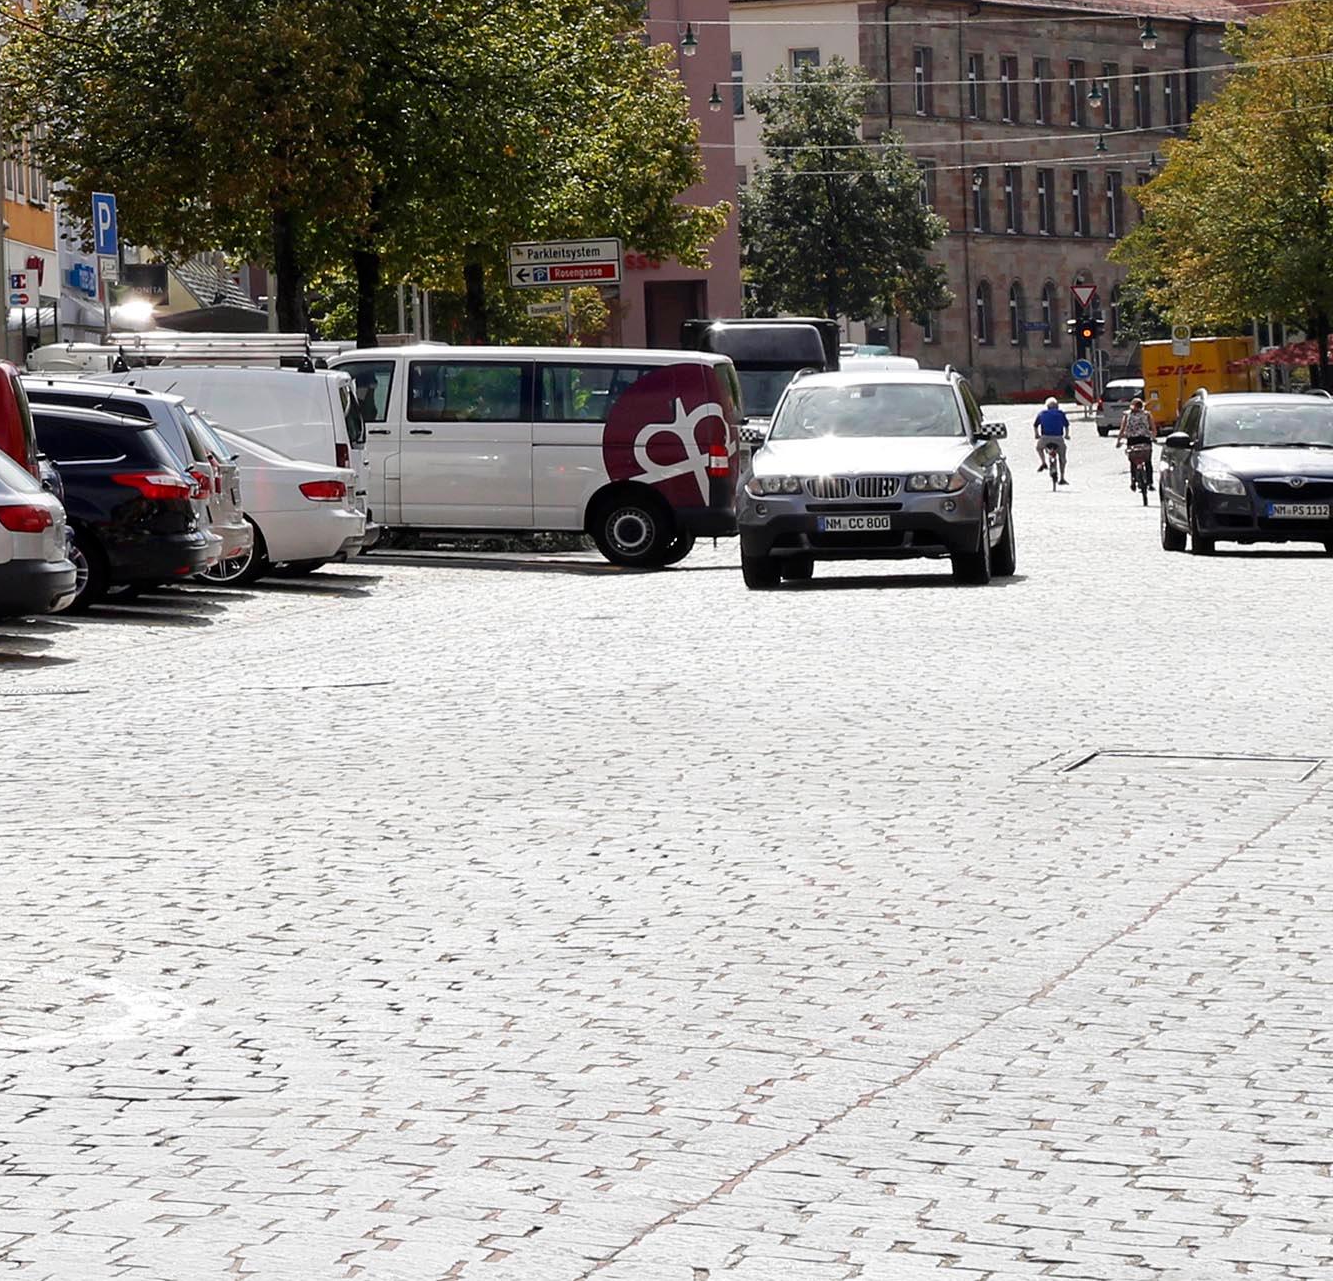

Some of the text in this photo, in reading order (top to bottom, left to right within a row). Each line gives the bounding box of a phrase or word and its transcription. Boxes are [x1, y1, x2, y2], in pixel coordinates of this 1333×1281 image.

[97, 201, 112, 247] P
[527, 247, 601, 261] Parkleitsystem
[554, 268, 603, 279] Rosengasse
[1156, 364, 1206, 376] DHL
[825, 517, 889, 529] NM CC 800
